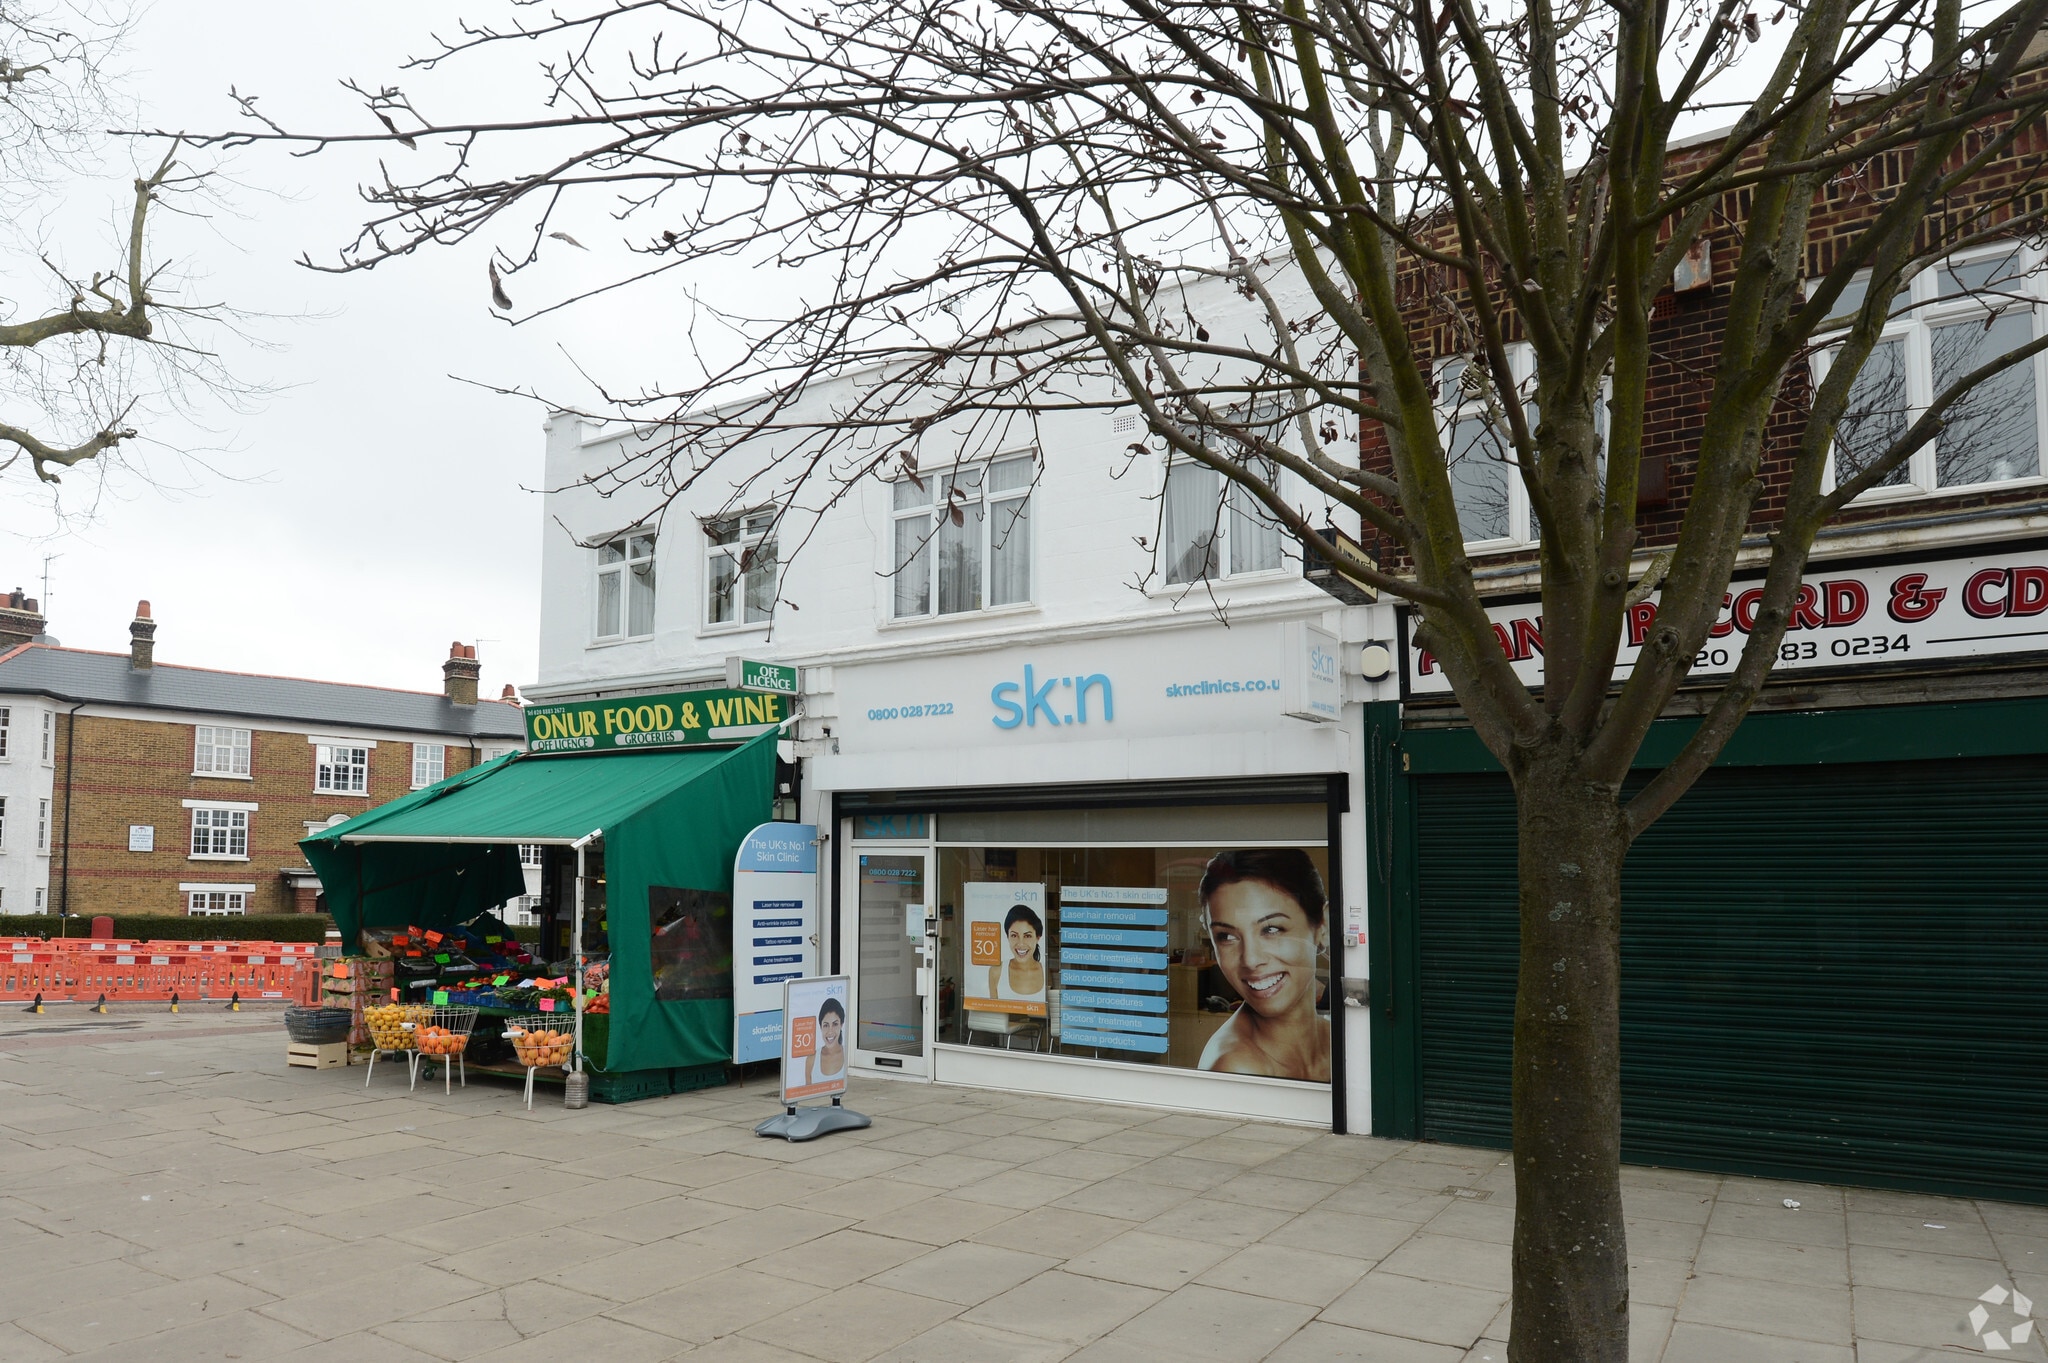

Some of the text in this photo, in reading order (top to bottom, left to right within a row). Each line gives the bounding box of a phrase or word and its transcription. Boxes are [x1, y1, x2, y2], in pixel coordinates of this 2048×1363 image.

[1626, 580, 1869, 647] RCORD
[1887, 572, 1948, 623] &
[1692, 649, 1729, 667] 20
[1831, 634, 1911, 657] 0234
[759, 666, 780, 678] OFF
[747, 674, 791, 690] LICENCE
[1166, 677, 1280, 697] sknclinics.co.u
[533, 694, 780, 739] ONUR FOOD & WINE
[868, 702, 954, 721] 0800 028 7222
[538, 738, 588, 750] OFF LICENCE
[625, 731, 675, 744] GROCERIES
[751, 839, 805, 851] The UK's No.1
[757, 852, 799, 862] Skin Clinic
[1063, 889, 1163, 900] The UK's No.1 skin clinic
[1063, 910, 1137, 921] Laser hair removal
[1063, 930, 1123, 941] Tattoo removal
[1062, 951, 1144, 964] Cosmetic treatments
[1063, 972, 1125, 984] Skin conditions
[1063, 992, 1144, 1008] Surgical procedures
[1063, 1012, 1143, 1028] Doctors' treatments
[752, 1023, 783, 1035] sknclinic
[1063, 1031, 1136, 1046] Skincare products
